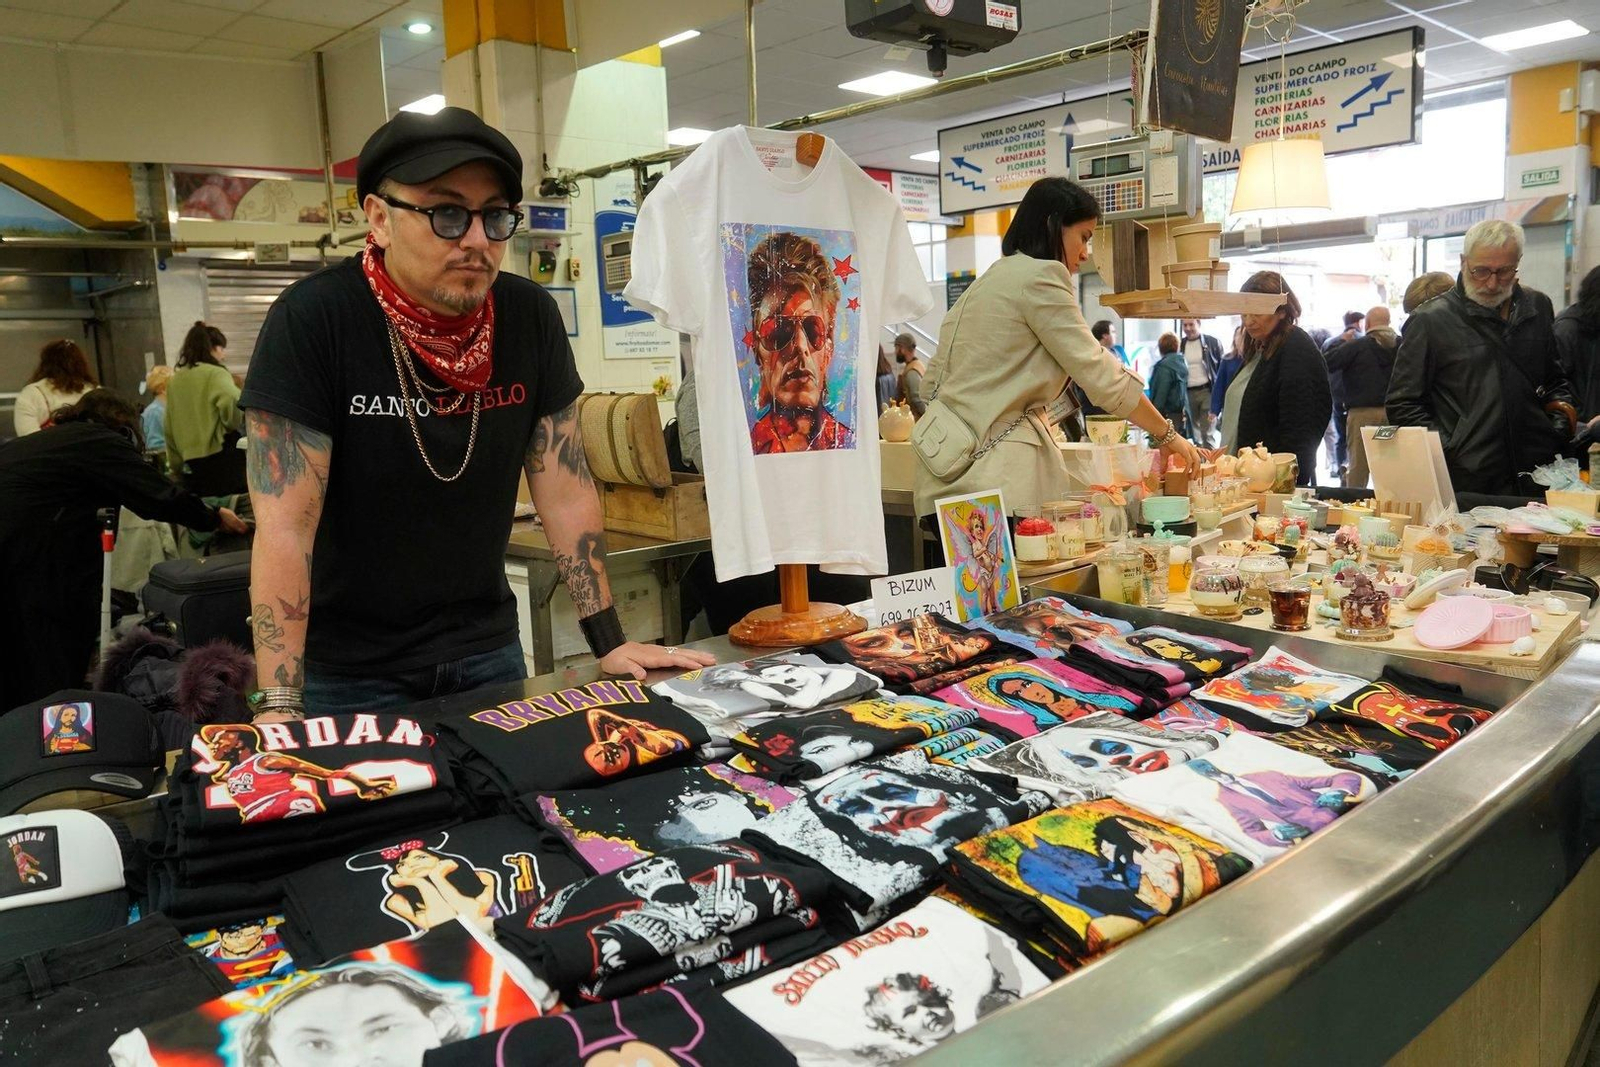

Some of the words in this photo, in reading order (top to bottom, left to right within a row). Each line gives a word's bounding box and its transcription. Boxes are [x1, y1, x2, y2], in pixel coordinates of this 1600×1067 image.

[989, 8, 1014, 18] ROSAS
[1254, 69, 1286, 83] VENTA
[1289, 65, 1305, 76] DO
[1307, 57, 1347, 72] CAMPO
[1254, 71, 1340, 95] SUPERMERCADO
[1343, 63, 1378, 79] FROIZ
[1254, 87, 1313, 106] FROITERIAS
[1254, 97, 1326, 118] CARNIZARIAS
[980, 129, 1004, 139] VENTA
[1005, 125, 1017, 134] DO
[1018, 119, 1046, 131] CAMPO
[963, 134, 1021, 153] SUPERMERCADO
[1023, 129, 1046, 140] FROIZ
[1003, 138, 1046, 153] FROITERIAS
[995, 148, 1047, 164] CARNIZARIAS
[1007, 158, 1047, 172] FLORERIAS
[1523, 171, 1558, 184] SALIDA
[349, 394, 431, 418] SANTO
[887, 576, 937, 597] BIZUM
[469, 679, 650, 732] BRYANT
[191, 714, 425, 774] JRDAN
[6, 830, 46, 848] JORDAN
[772, 953, 840, 1006] SANTO
[841, 921, 929, 958] DIABLO
